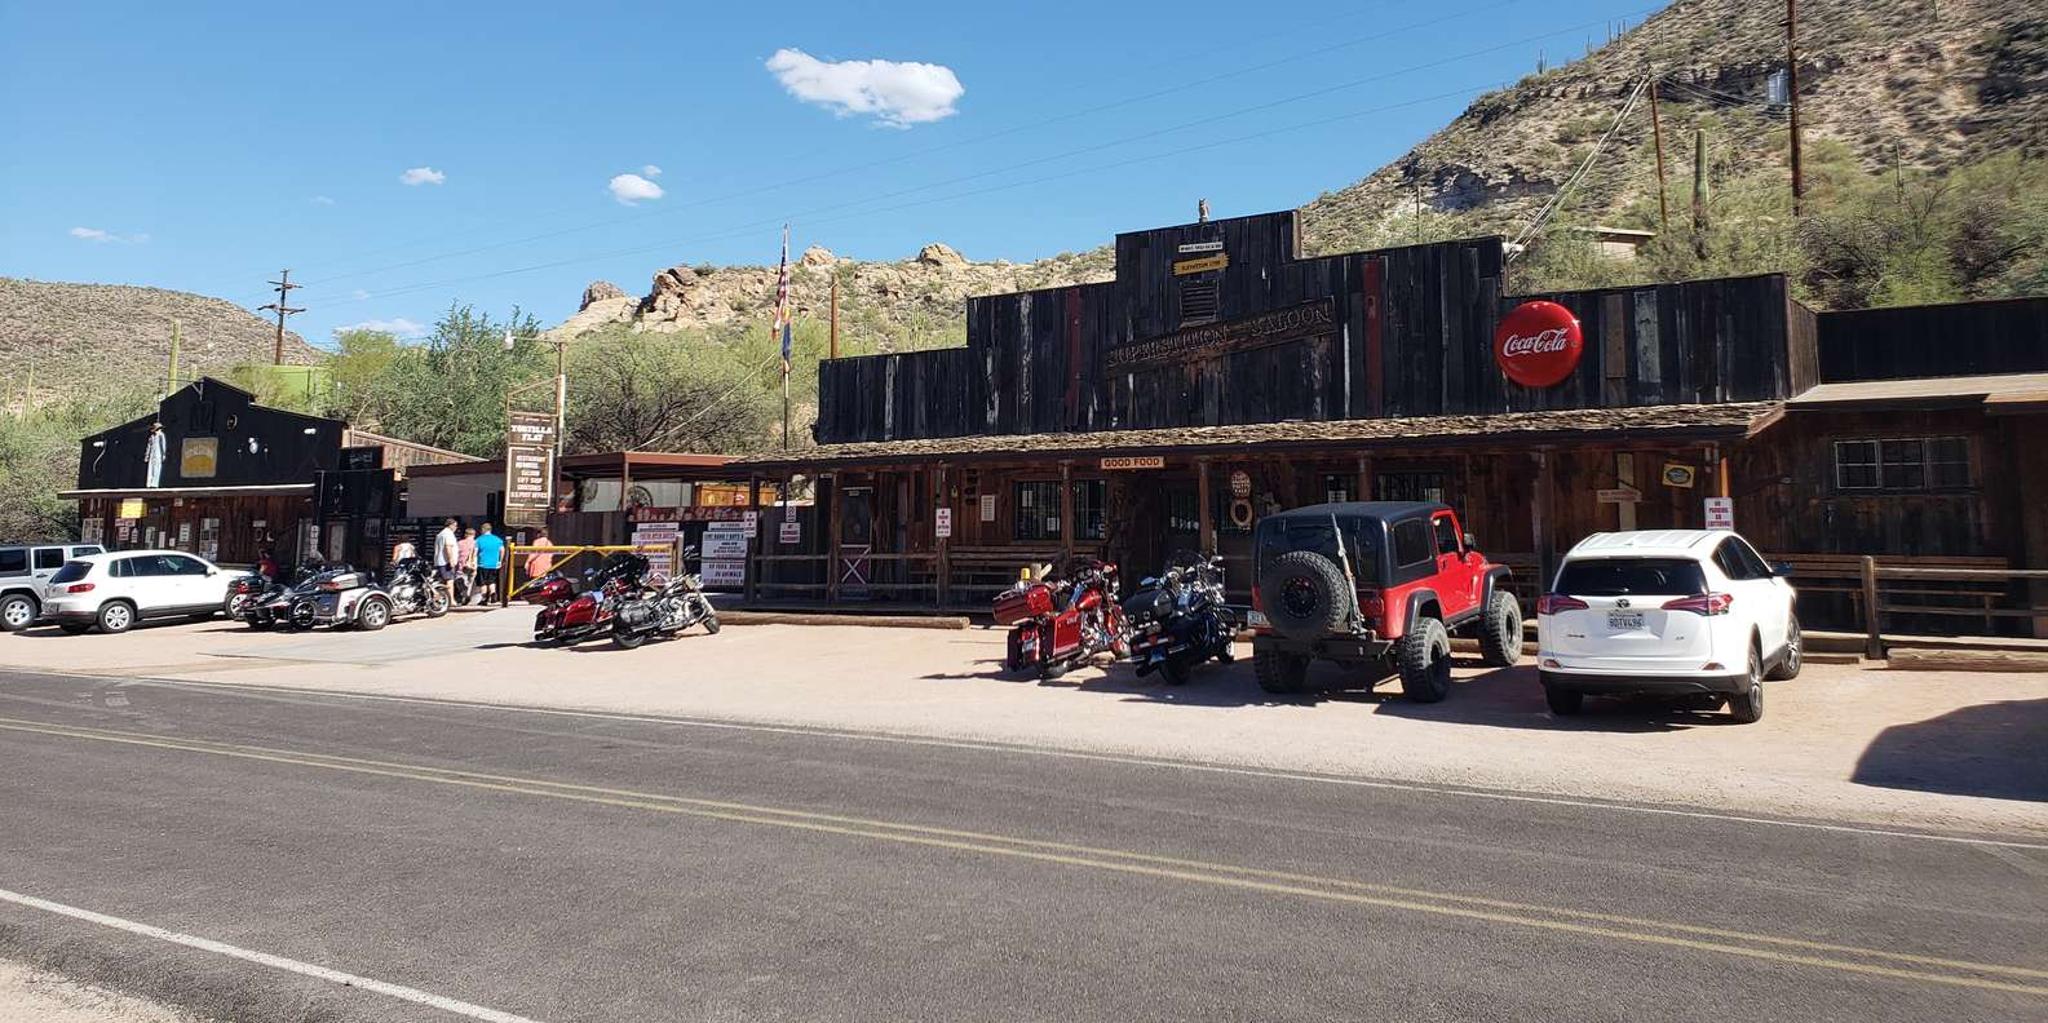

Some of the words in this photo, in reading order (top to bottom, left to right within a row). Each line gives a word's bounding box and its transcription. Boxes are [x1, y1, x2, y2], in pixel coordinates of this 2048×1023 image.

[1107, 325, 1230, 368] SUPERSTITION
[1250, 301, 1332, 337] SALOON
[1503, 327, 1569, 357] Coca-Cola
[511, 424, 553, 434] TORTILLA
[521, 433, 544, 442] FLAT
[1104, 458, 1131, 467] GOOD
[1134, 457, 1160, 466] FOOD
